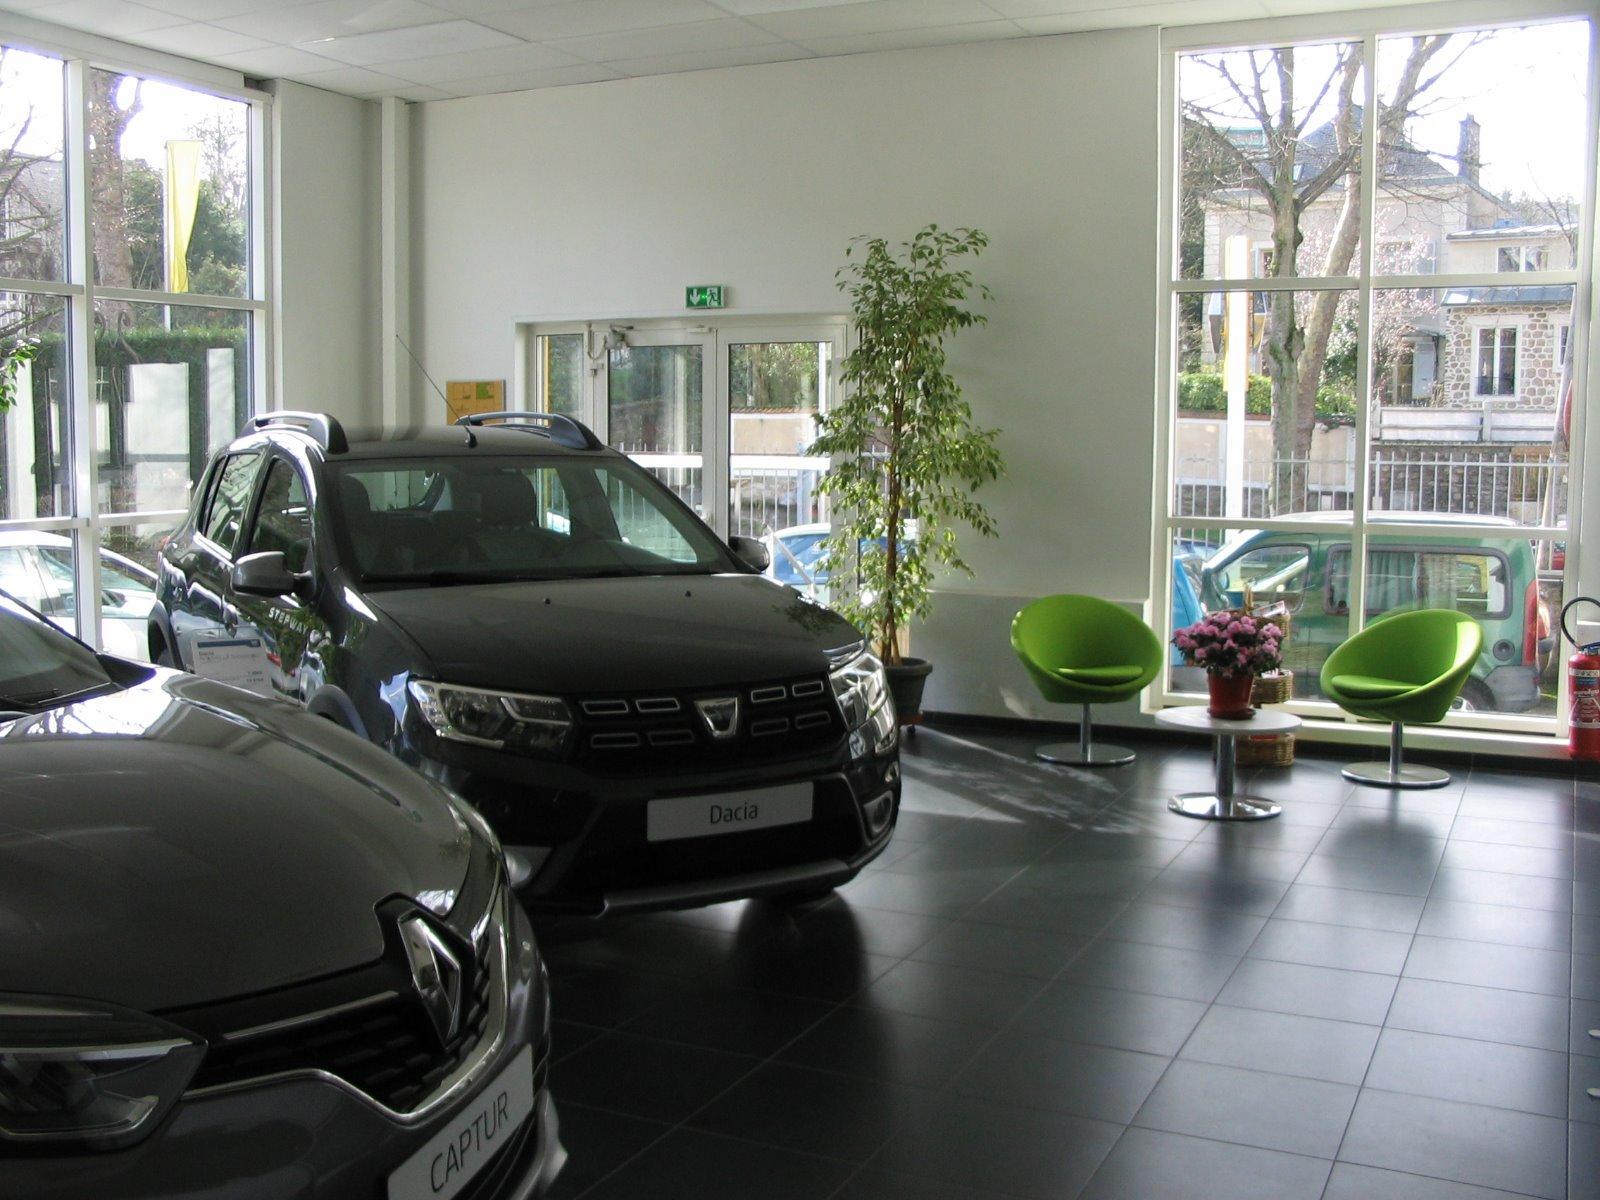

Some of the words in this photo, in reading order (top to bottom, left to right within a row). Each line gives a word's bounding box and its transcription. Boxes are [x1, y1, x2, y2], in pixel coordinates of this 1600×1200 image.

[268, 606, 309, 635] STEPWAY
[709, 801, 759, 825] Dacia
[430, 1091, 508, 1193] CAPTUR
